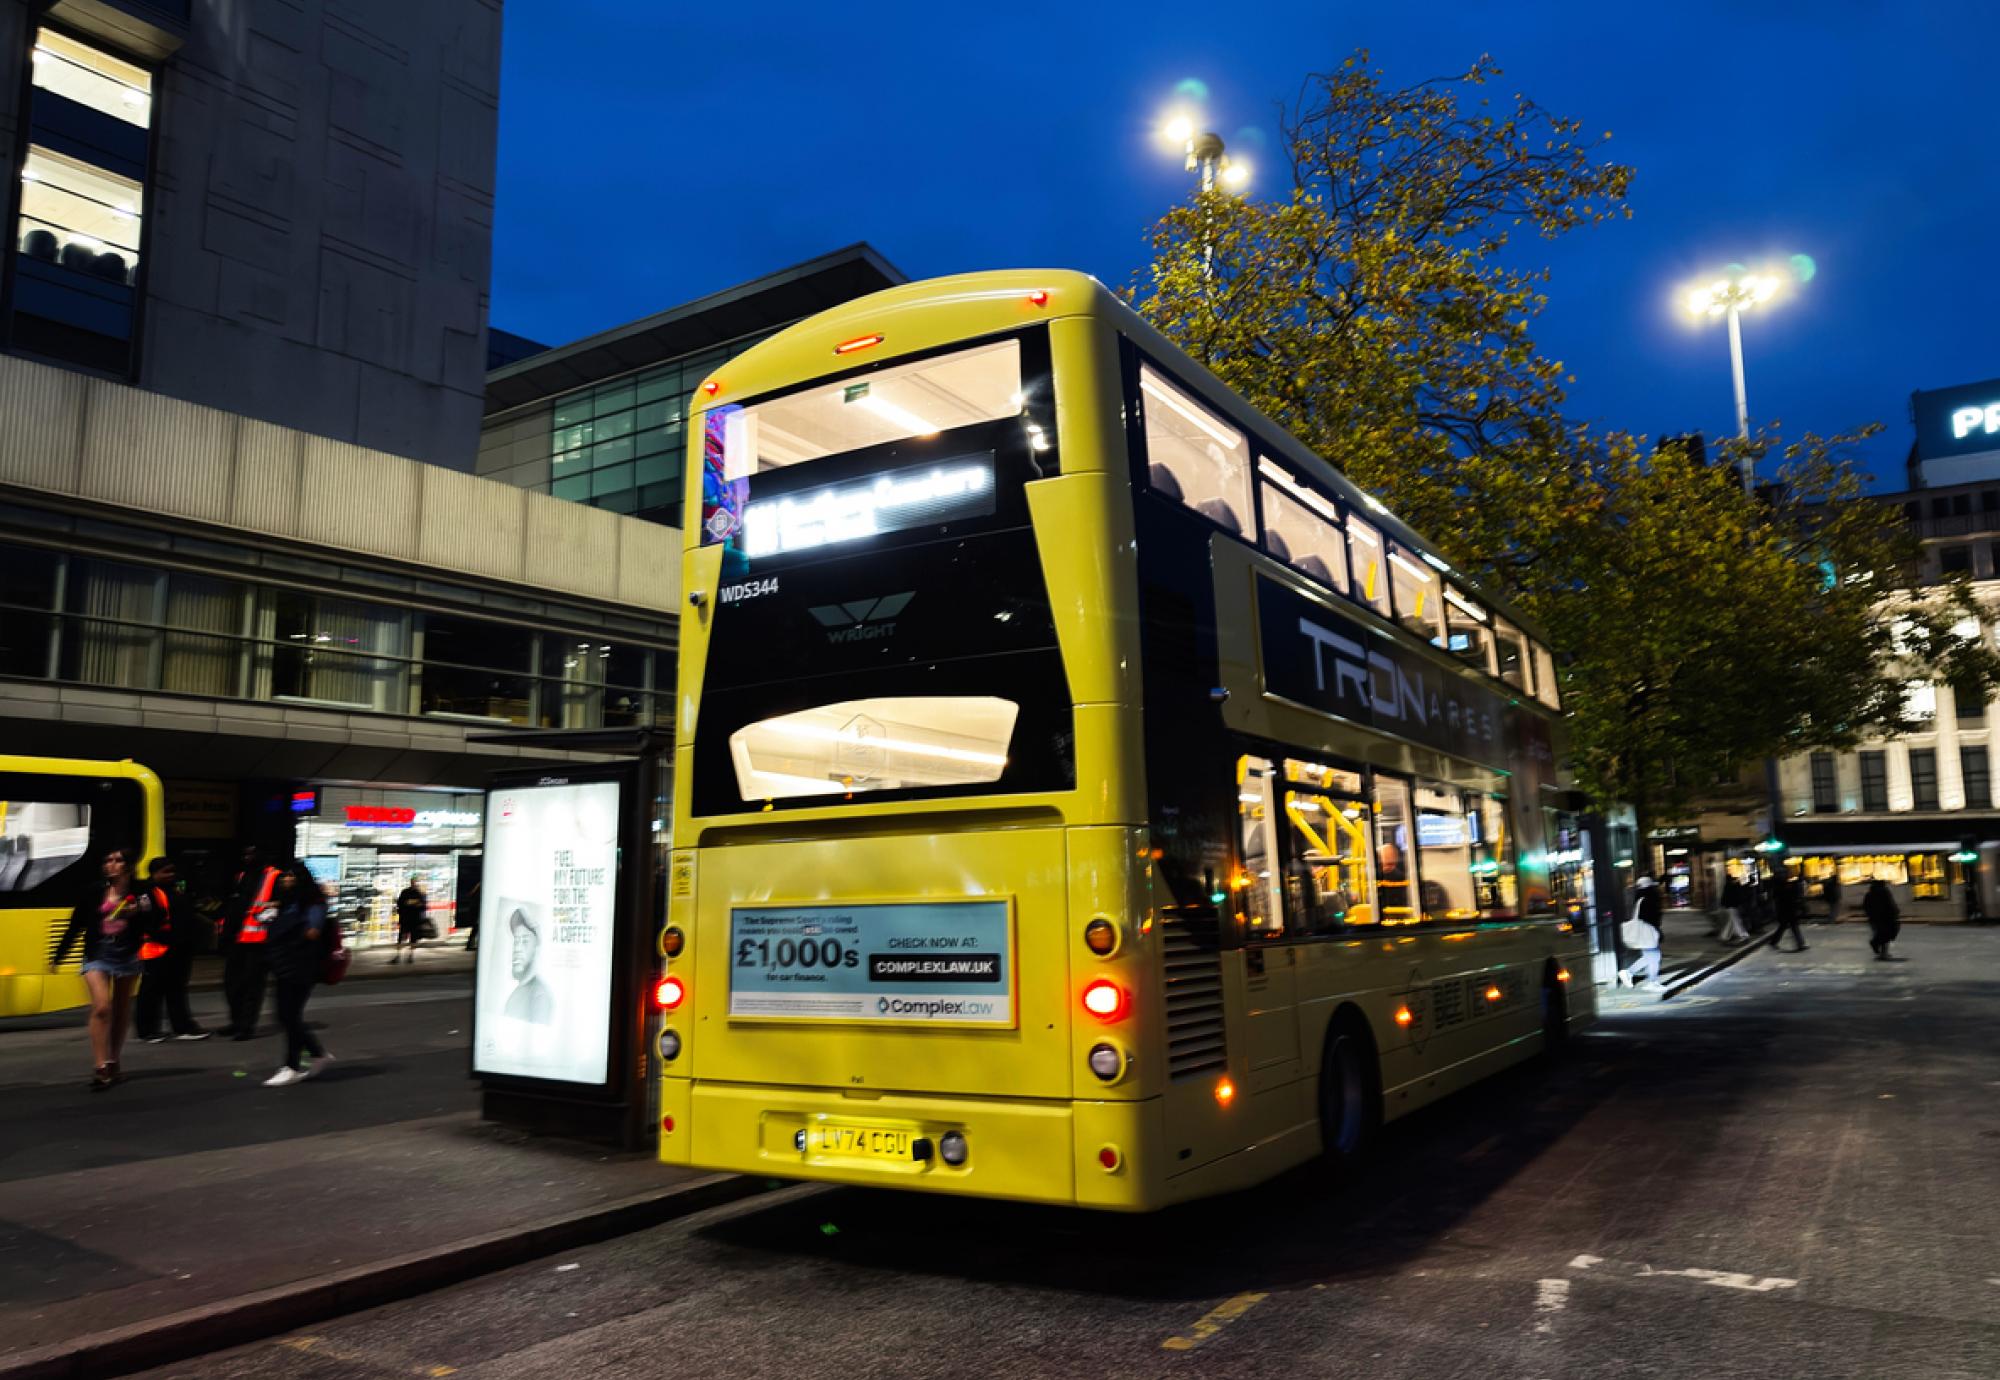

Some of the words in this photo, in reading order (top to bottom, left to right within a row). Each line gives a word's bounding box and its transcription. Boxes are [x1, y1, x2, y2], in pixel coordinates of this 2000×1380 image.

[720, 576, 779, 603] WDS344
[827, 622, 897, 644] WRIGHT
[1299, 616, 1428, 727] TRON
[1430, 692, 1493, 742] ARES
[569, 867, 605, 885] FUTURE
[554, 888, 571, 905] FOR
[888, 937, 927, 948] CHECK
[929, 937, 959, 948] NOW
[876, 960, 994, 974] COMPLEXLAW.UK
[891, 999, 993, 1018] ComplexLaw
